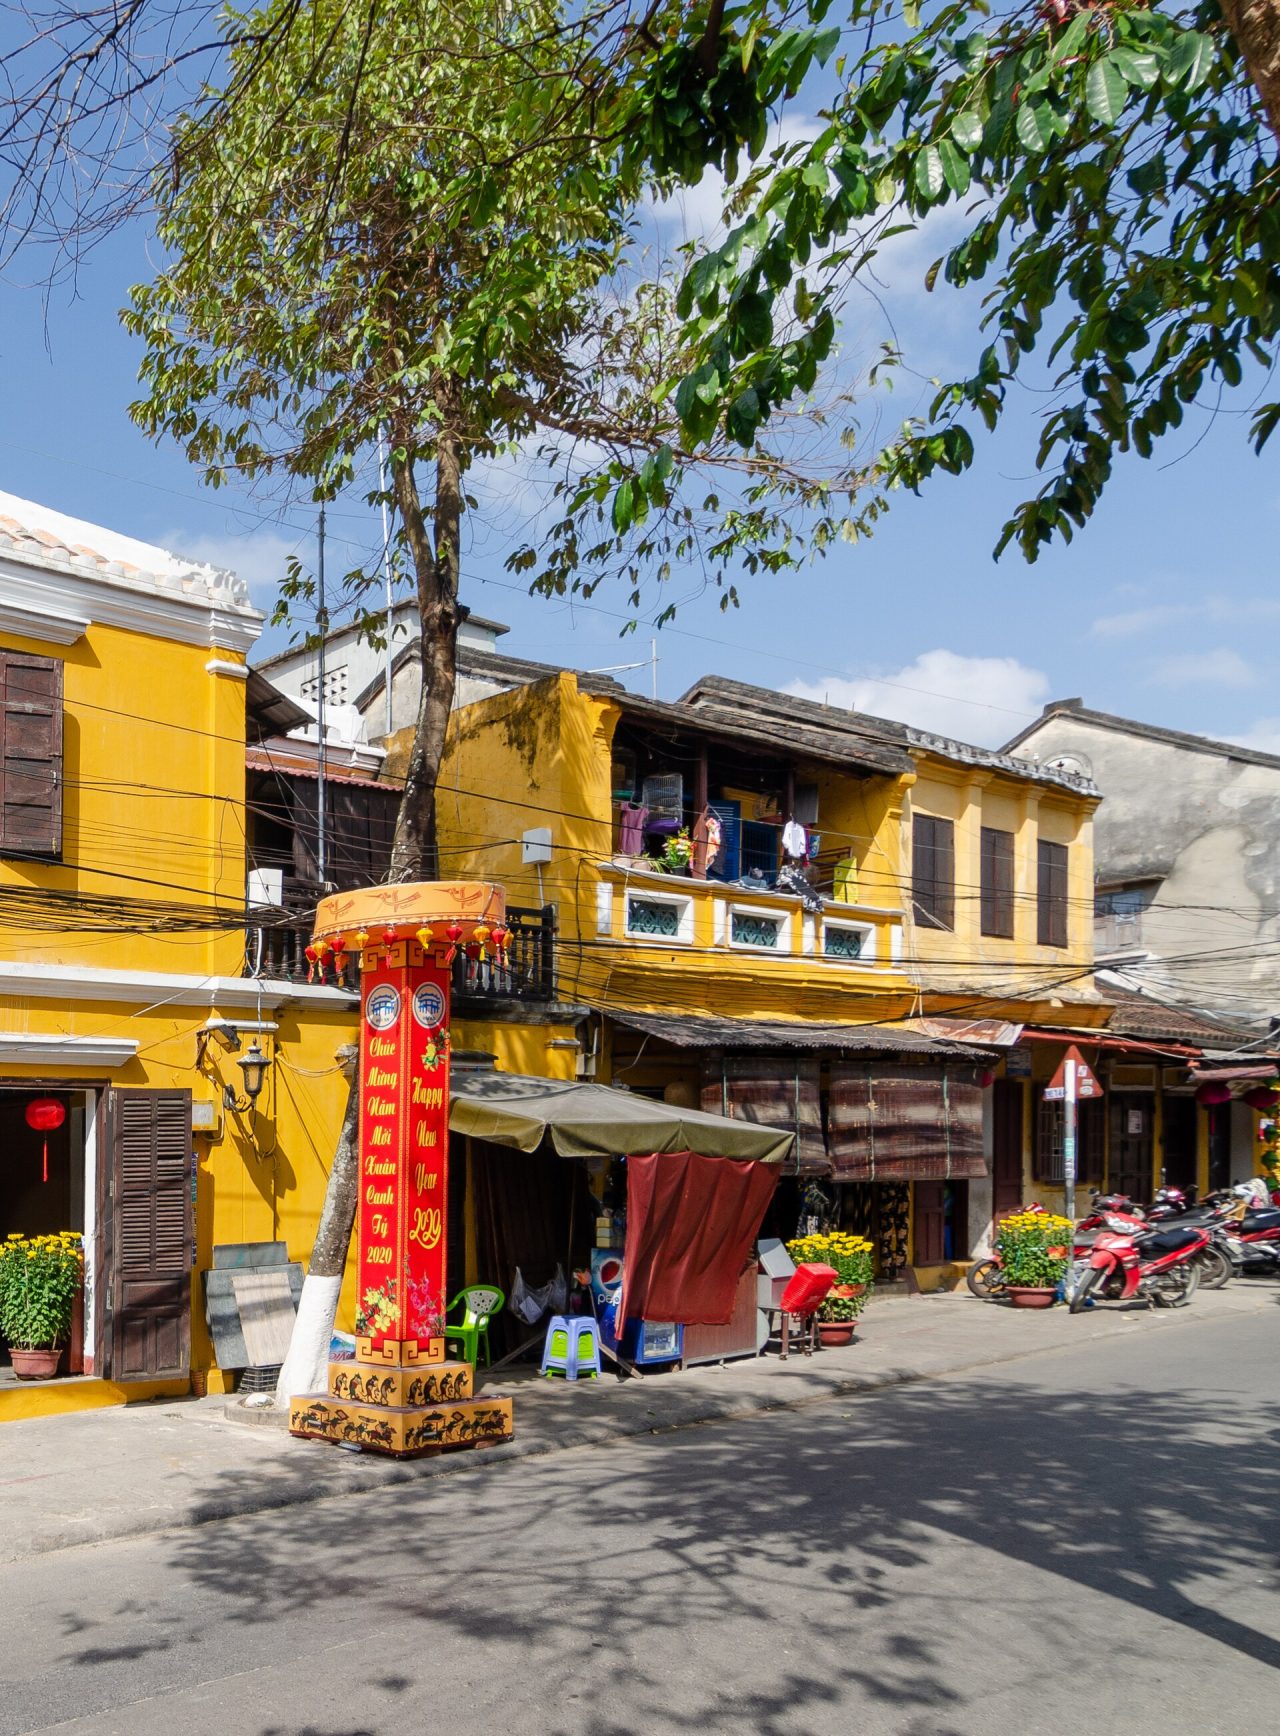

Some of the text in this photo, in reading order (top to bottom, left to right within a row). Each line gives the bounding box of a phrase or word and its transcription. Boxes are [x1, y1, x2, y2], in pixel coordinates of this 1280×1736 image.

[369, 1036, 396, 1058] Chúc
[366, 1066, 397, 1090] Mừng
[412, 1076, 443, 1110] Happy
[367, 1096, 396, 1117] Năm
[369, 1125, 392, 1146] Mới
[416, 1119, 437, 1148] New
[365, 1155, 397, 1176] Xuân
[414, 1162, 438, 1197] Year
[366, 1184, 395, 1205] Canh
[371, 1213, 388, 1239] Tý
[366, 1246, 393, 1265] 2020
[598, 1293, 620, 1306] pep
